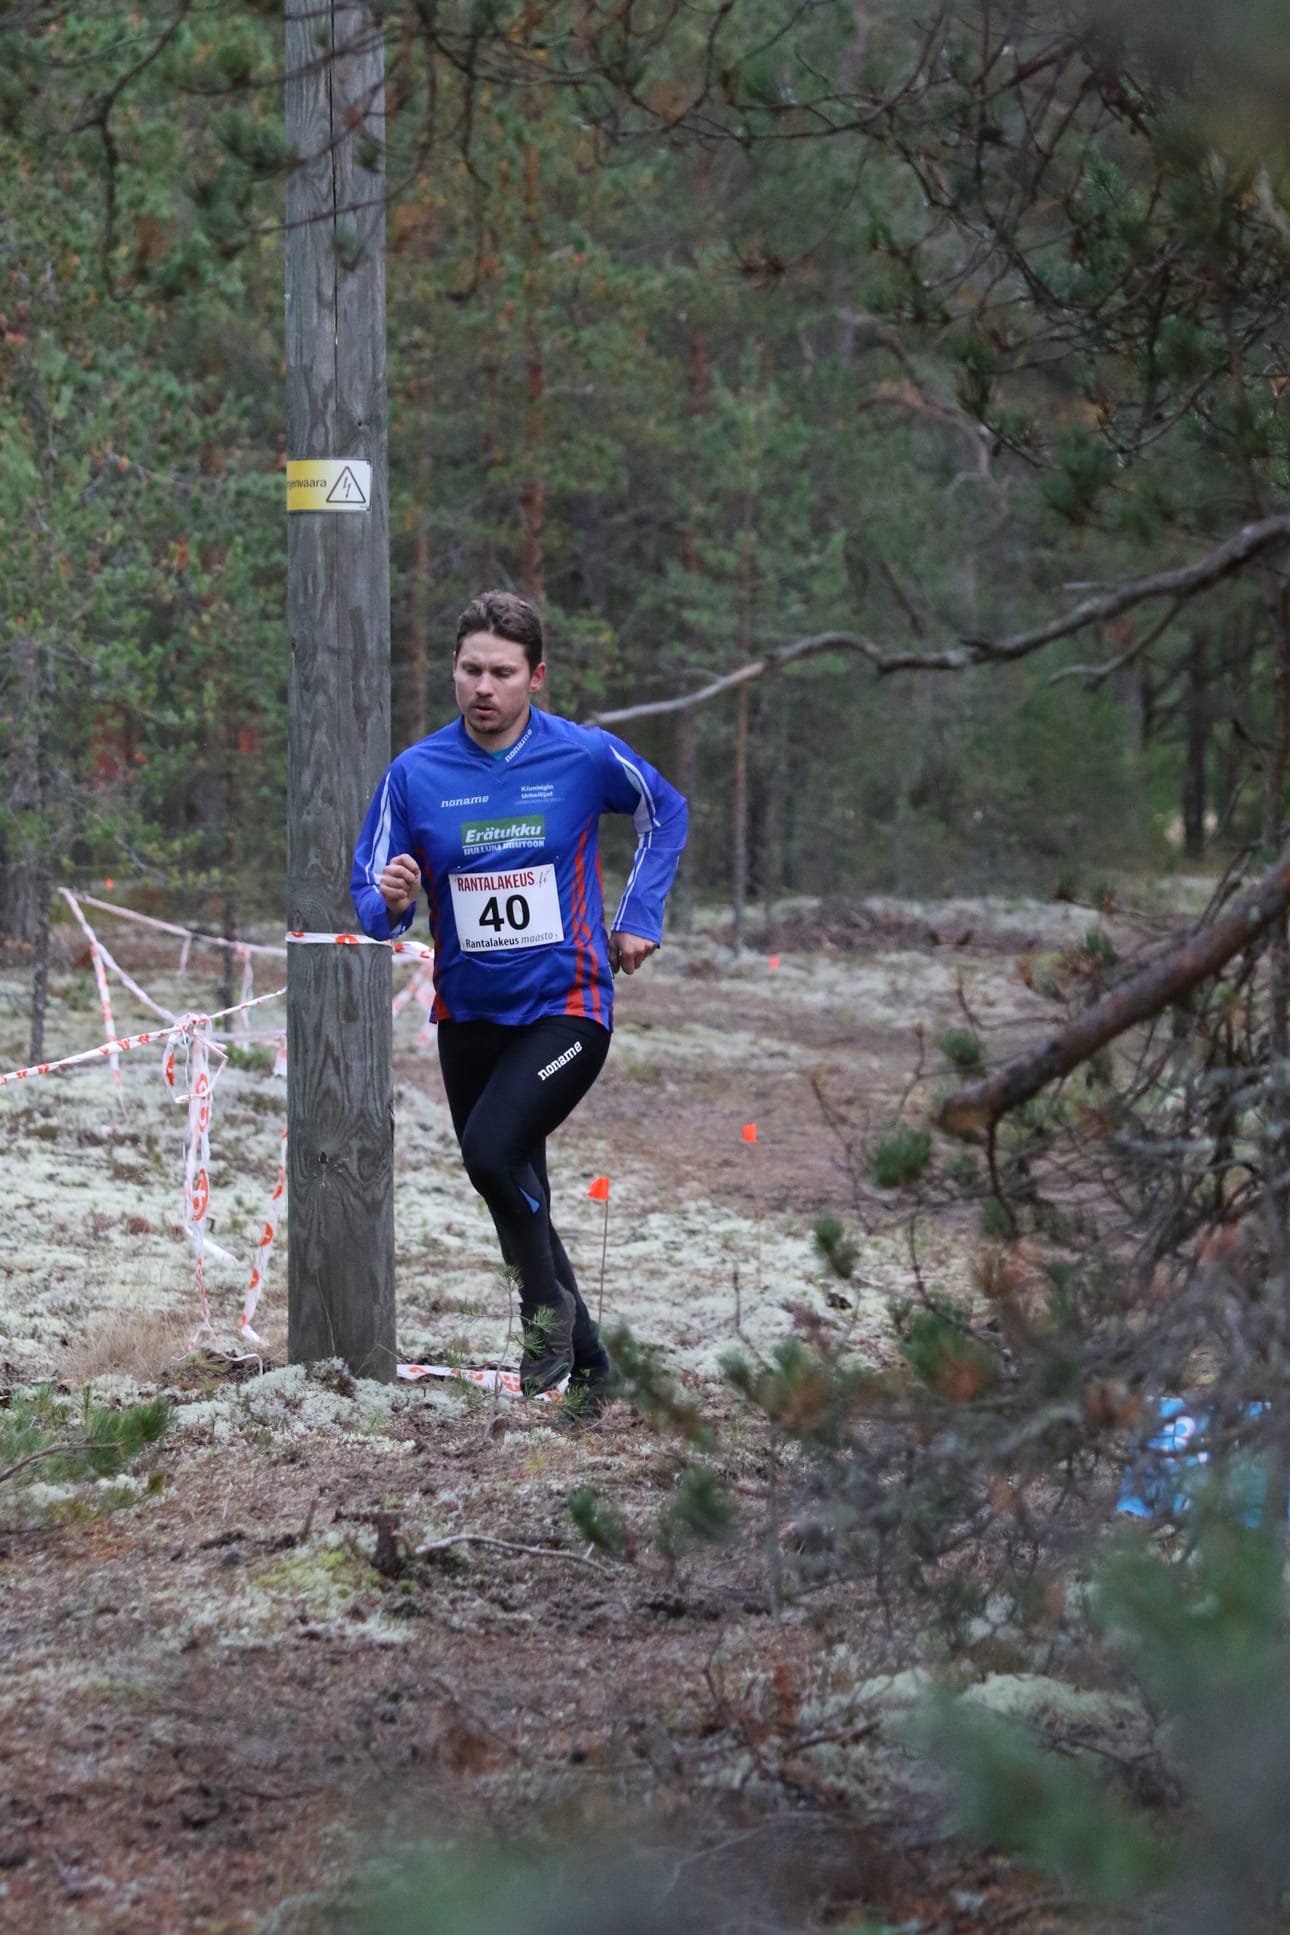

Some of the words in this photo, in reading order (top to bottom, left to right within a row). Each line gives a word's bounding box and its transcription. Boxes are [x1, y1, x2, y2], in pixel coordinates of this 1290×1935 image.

[505, 728, 533, 763] noname
[440, 795, 489, 808] noname
[465, 823, 542, 843] Erätukku
[479, 894, 531, 932] 40
[465, 937, 519, 949] Rantalakeus
[537, 1041, 583, 1081] noname
